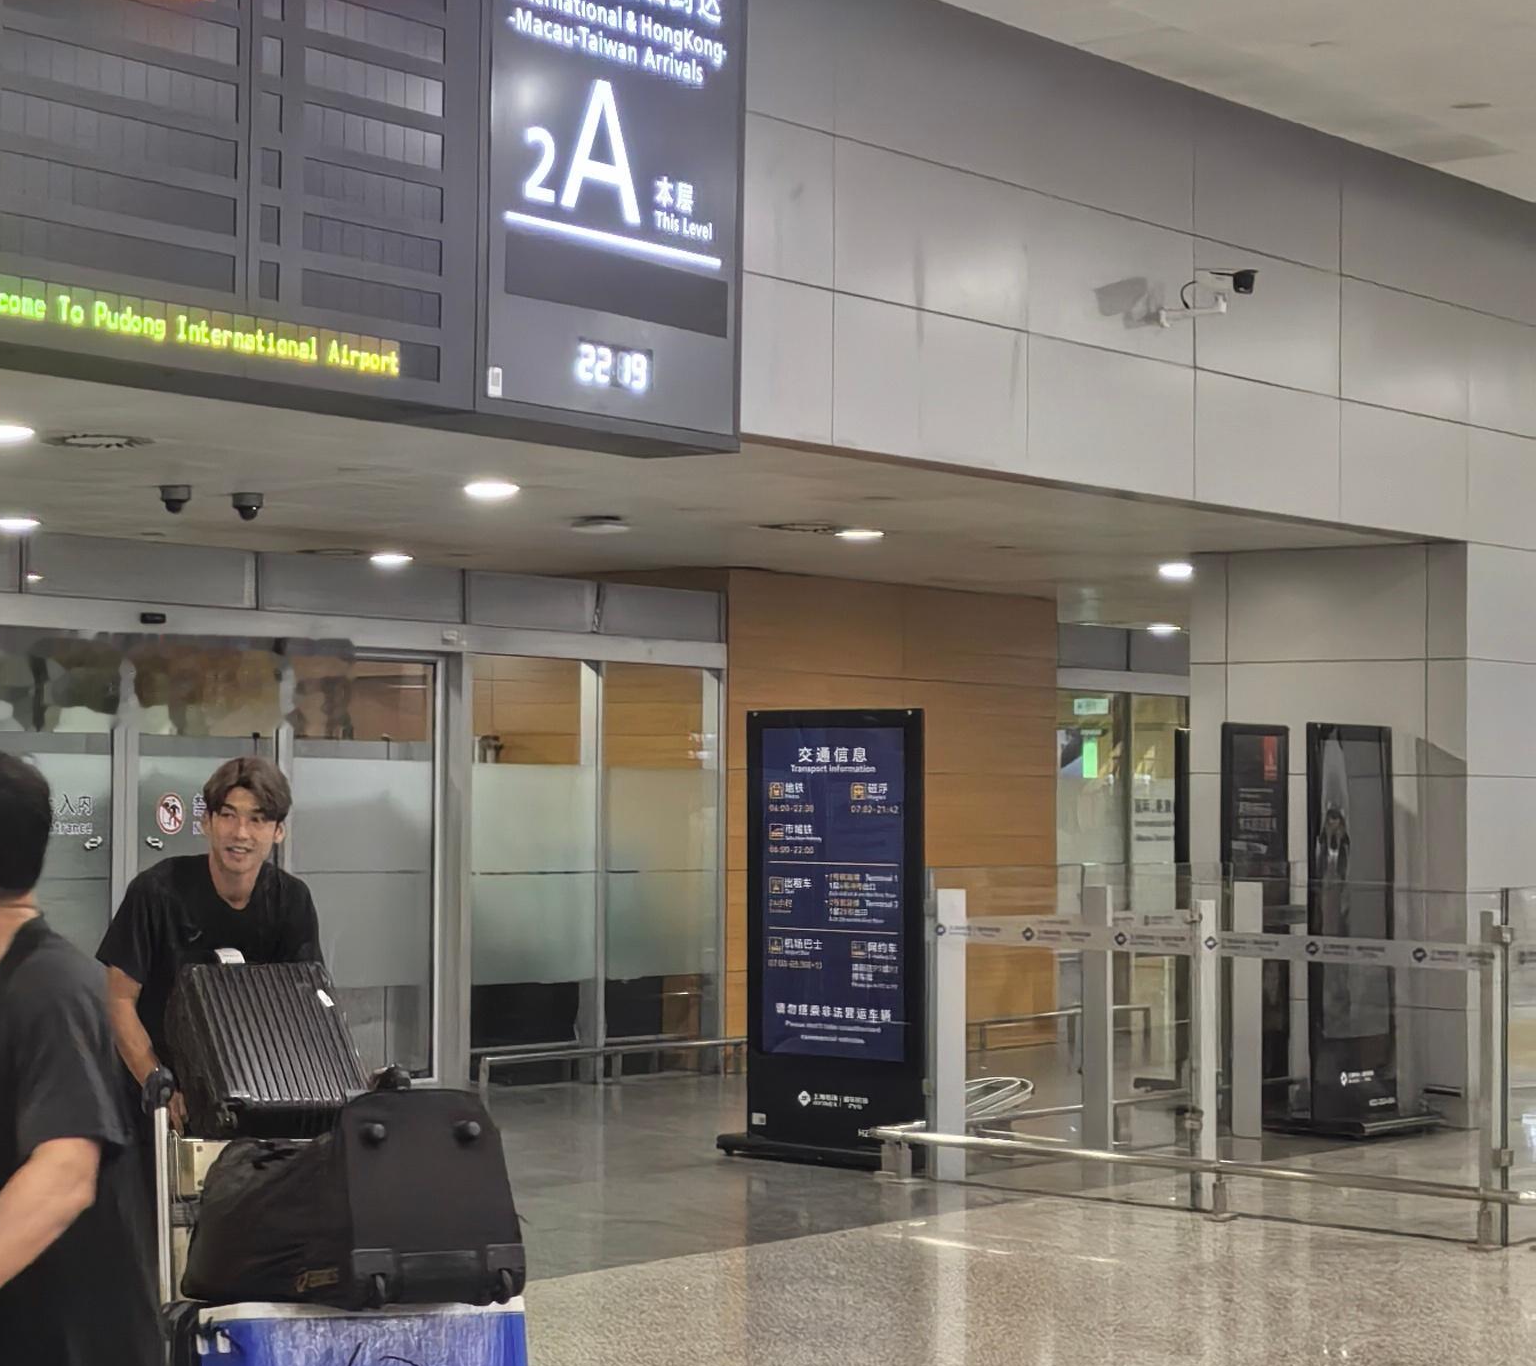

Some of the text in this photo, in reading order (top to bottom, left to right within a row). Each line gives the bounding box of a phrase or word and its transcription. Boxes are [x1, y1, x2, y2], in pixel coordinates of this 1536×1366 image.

[625, 8, 637, 35] &
[508, 13, 704, 84] -Macau-Taiwan Arrivals
[524, 79, 641, 225] 2A
[654, 177, 694, 213] 本层
[654, 210, 712, 241] This Level
[58, 294, 84, 328] To
[93, 301, 166, 343] Pudong
[176, 315, 318, 363] International
[328, 340, 400, 377] Airport
[798, 747, 867, 763] 交通信息
[49, 794, 93, 816] 入内
[784, 938, 823, 950] 机场巴士
